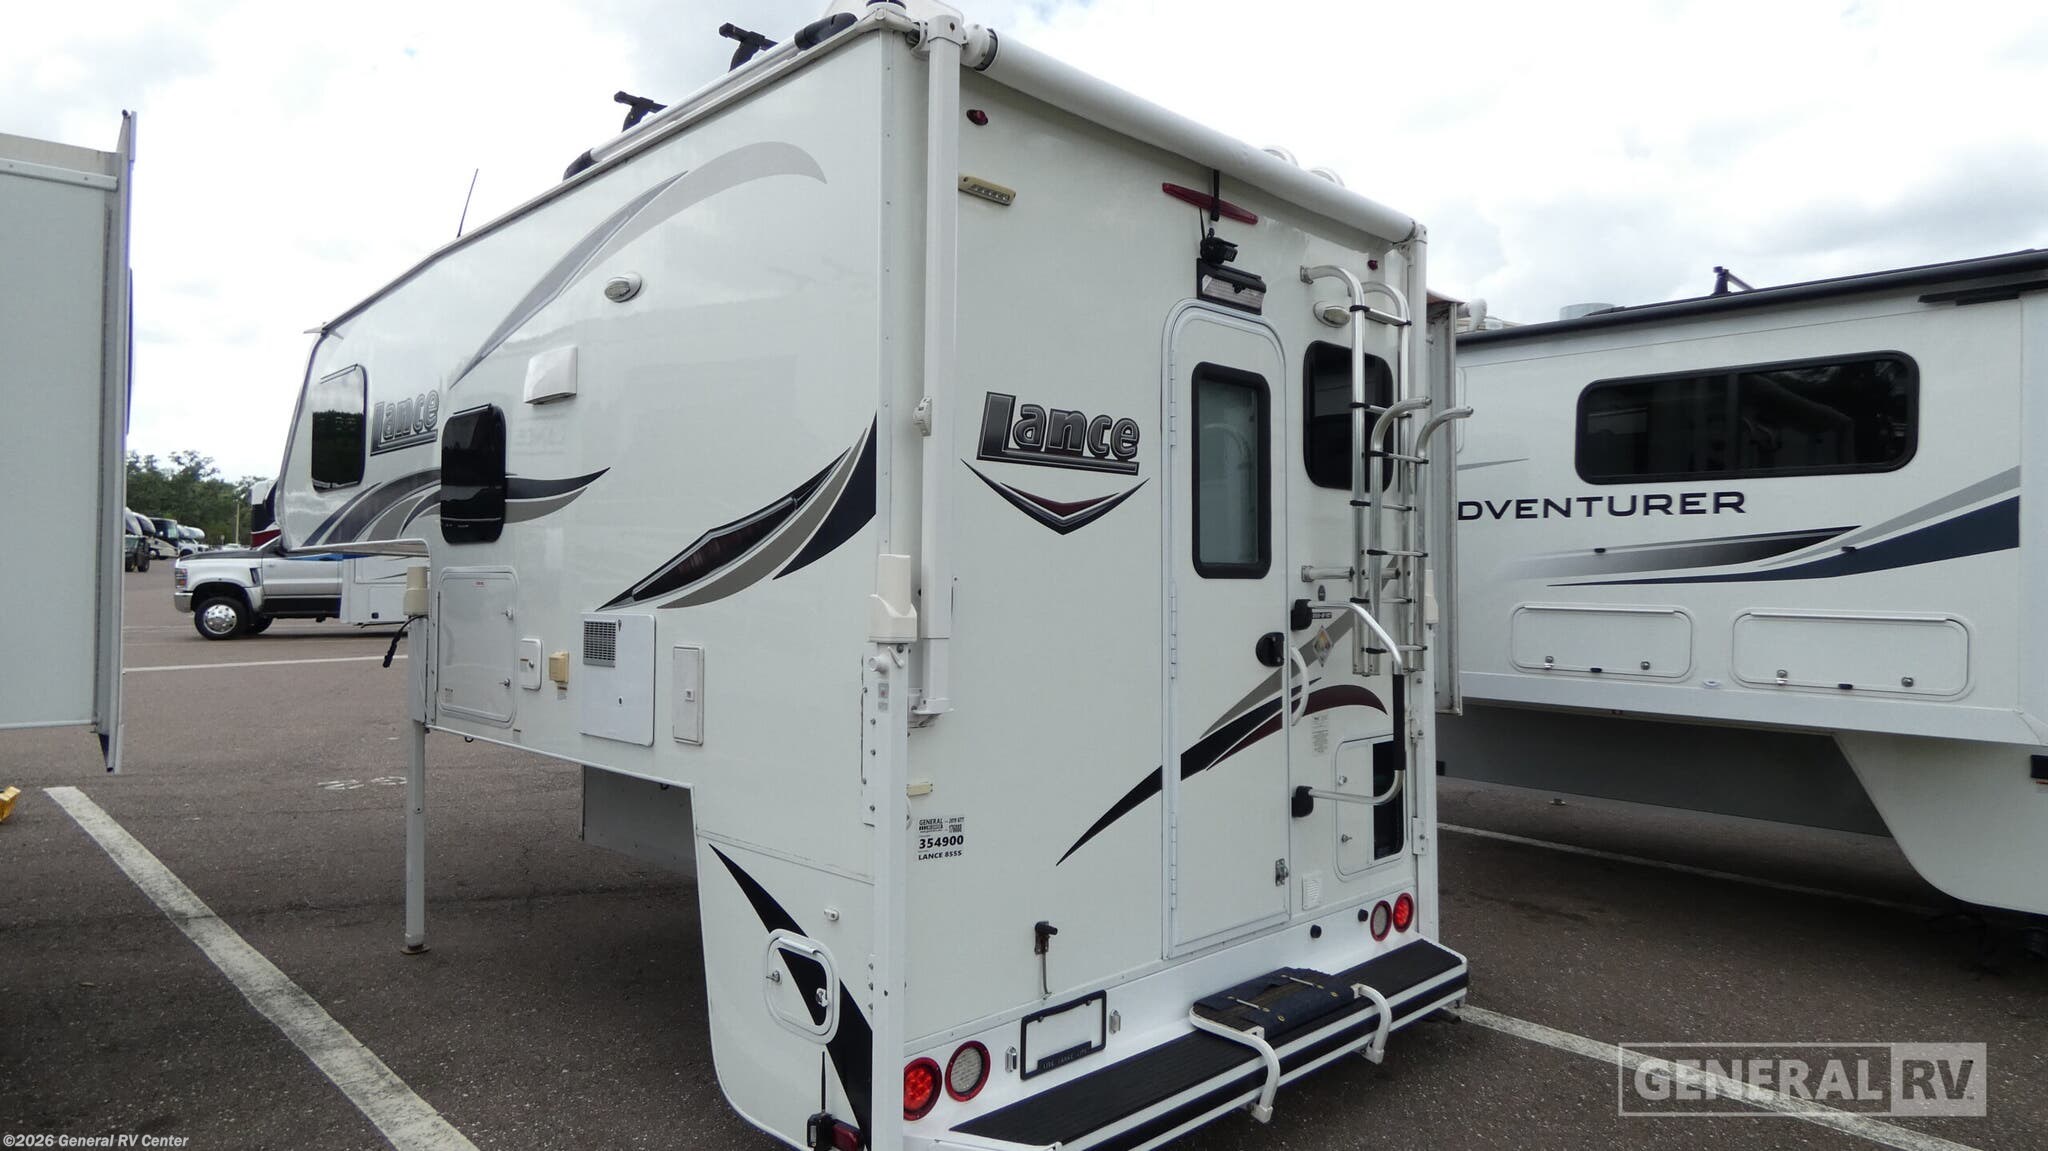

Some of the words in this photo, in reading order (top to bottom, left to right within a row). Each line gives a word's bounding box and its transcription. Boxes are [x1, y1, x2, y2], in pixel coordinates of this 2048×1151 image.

[370, 389, 439, 456] Lance
[977, 391, 1140, 476] Lance
[1457, 491, 1746, 521] DVENTURER
[918, 851, 943, 860] LANCE
[919, 834, 964, 849] 354900
